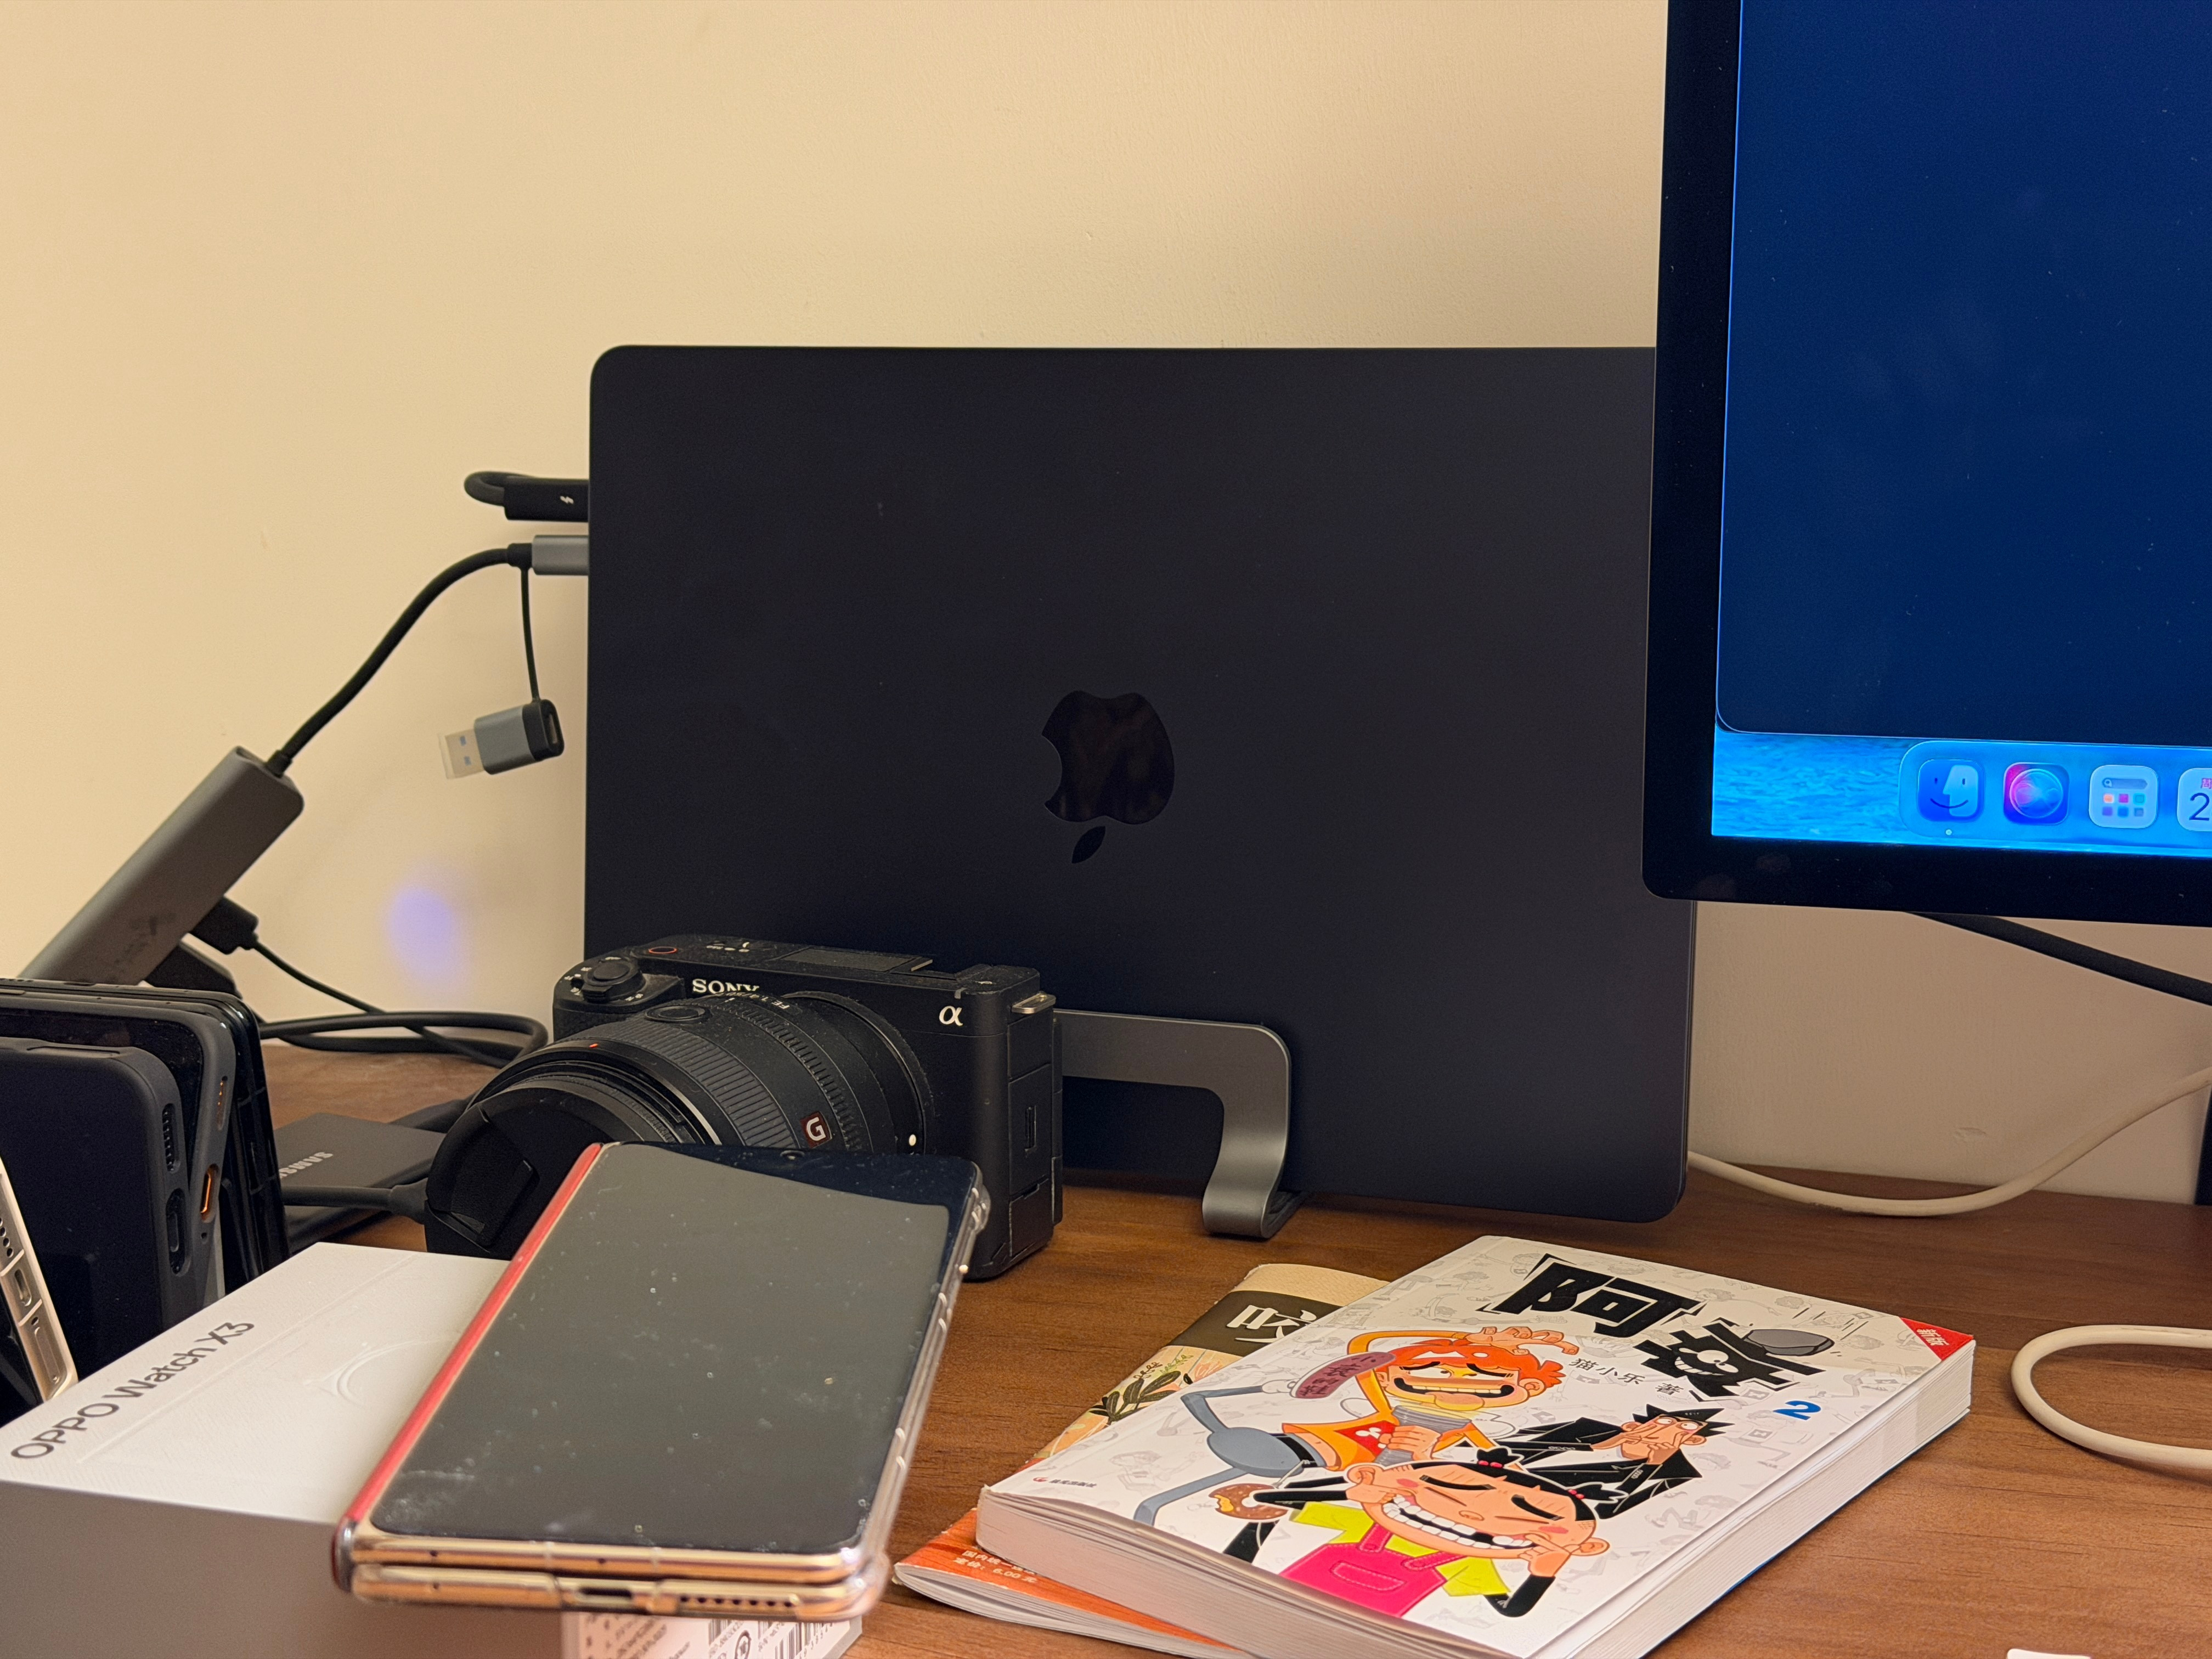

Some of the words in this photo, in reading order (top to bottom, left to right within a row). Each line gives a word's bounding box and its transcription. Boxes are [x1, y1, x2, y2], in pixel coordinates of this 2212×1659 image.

[806, 1116, 827, 1142] G
[1916, 1328, 1950, 1346] 新版
[1568, 1358, 1645, 1385] 猫小乐
[1655, 1382, 1684, 1396] 著
[11, 1402, 120, 1459] OPPO
[102, 1346, 217, 1400] Watch
[194, 1322, 255, 1346] X3
[1773, 1400, 1823, 1420] 2
[992, 1568, 1022, 1579] 6.00
